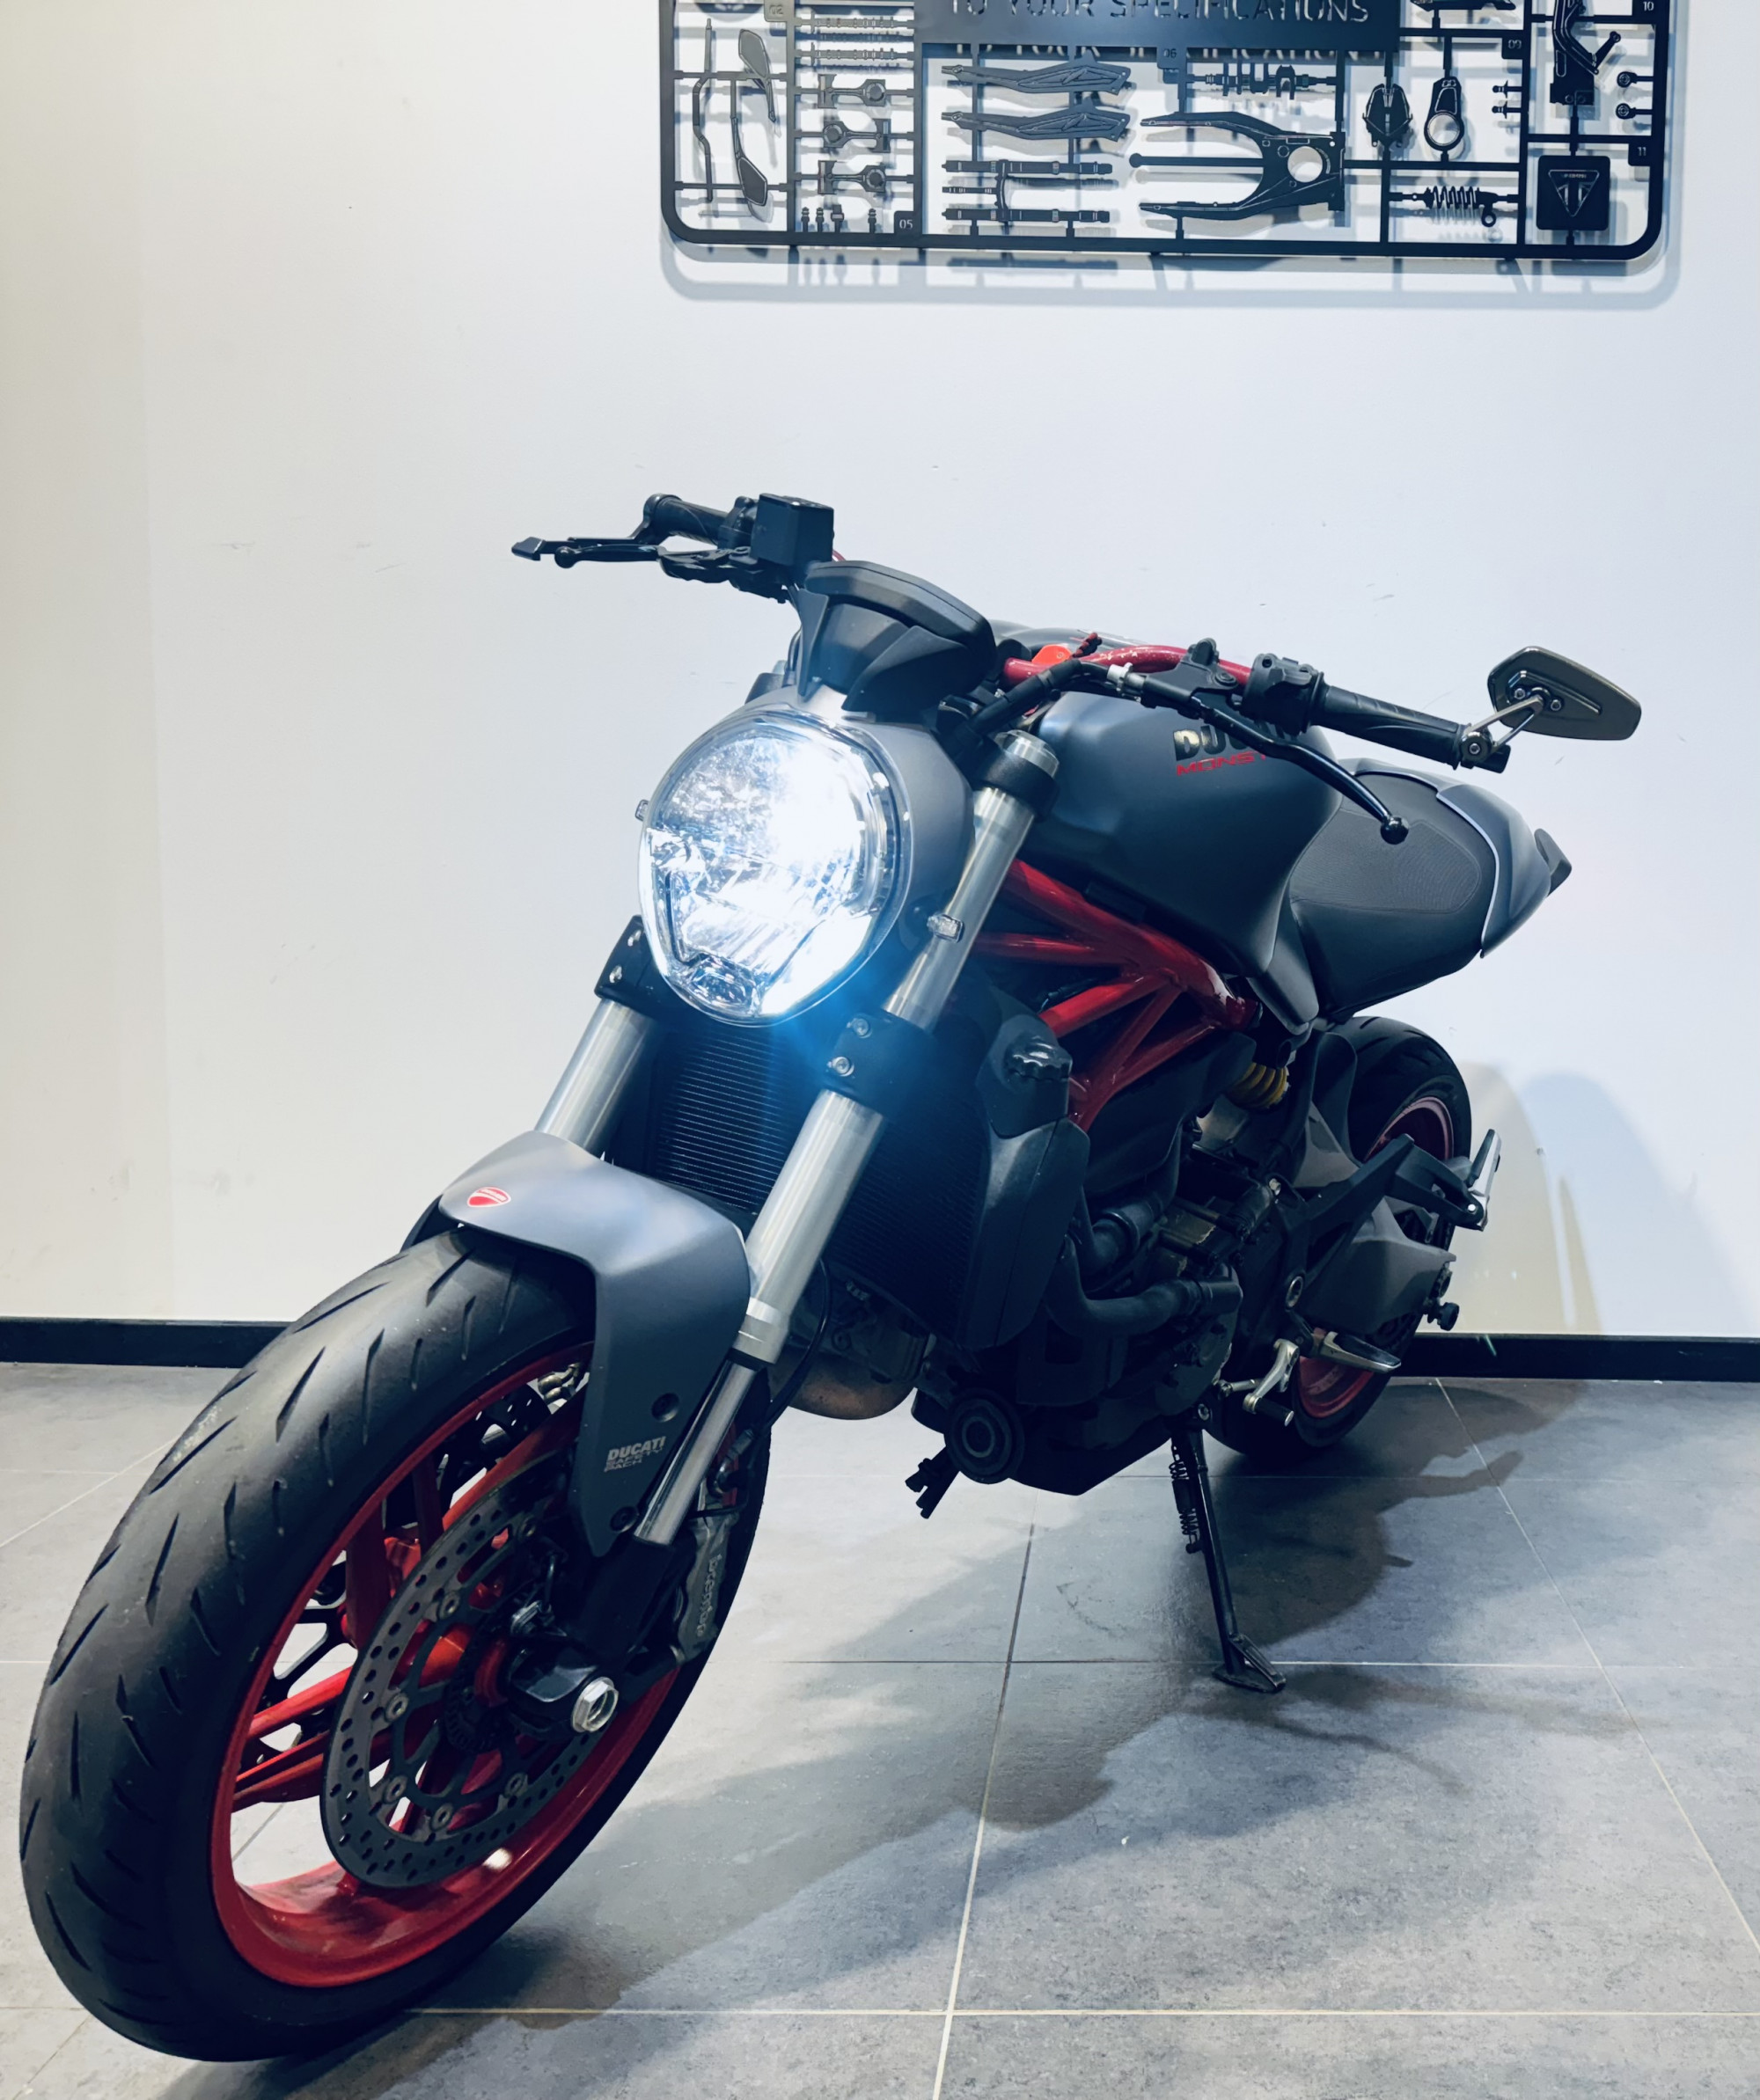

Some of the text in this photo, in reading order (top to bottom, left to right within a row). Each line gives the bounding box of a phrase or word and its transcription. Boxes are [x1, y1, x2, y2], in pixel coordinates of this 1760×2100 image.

[1642, 1, 1654, 11] 10
[1507, 39, 1522, 50] 09
[1163, 48, 1177, 58] 06
[1637, 146, 1646, 157] 11
[898, 219, 913, 230] 05
[606, 1436, 666, 1461] DUCATI
